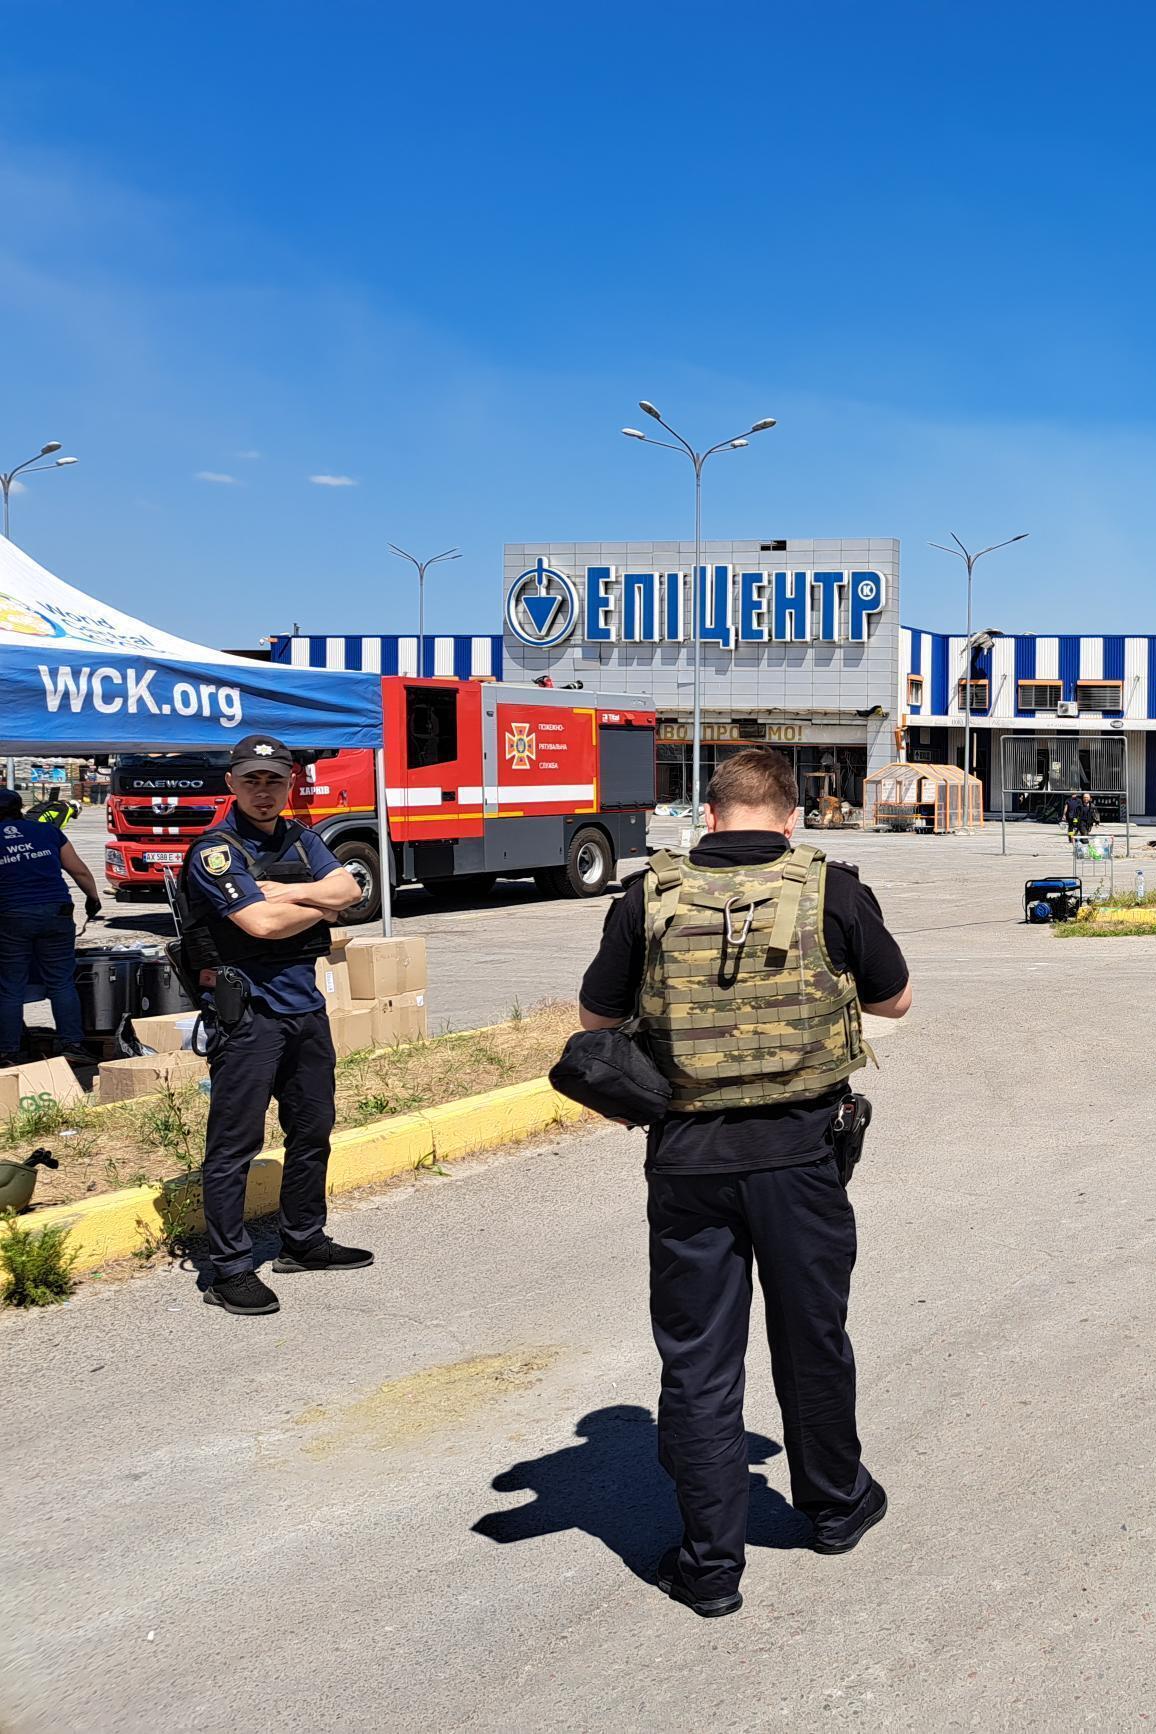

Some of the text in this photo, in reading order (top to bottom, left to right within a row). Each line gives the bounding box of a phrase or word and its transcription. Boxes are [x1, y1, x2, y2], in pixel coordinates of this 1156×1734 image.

[36, 600, 116, 630] World
[585, 564, 886, 649] ЕПІЦЕНТР
[37, 665, 243, 728] WCK.org
[703, 724, 804, 742] ПРОМО!
[133, 779, 204, 789] DAEWOO
[6, 842, 35, 854] WCK
[23, 849, 52, 860] Team
